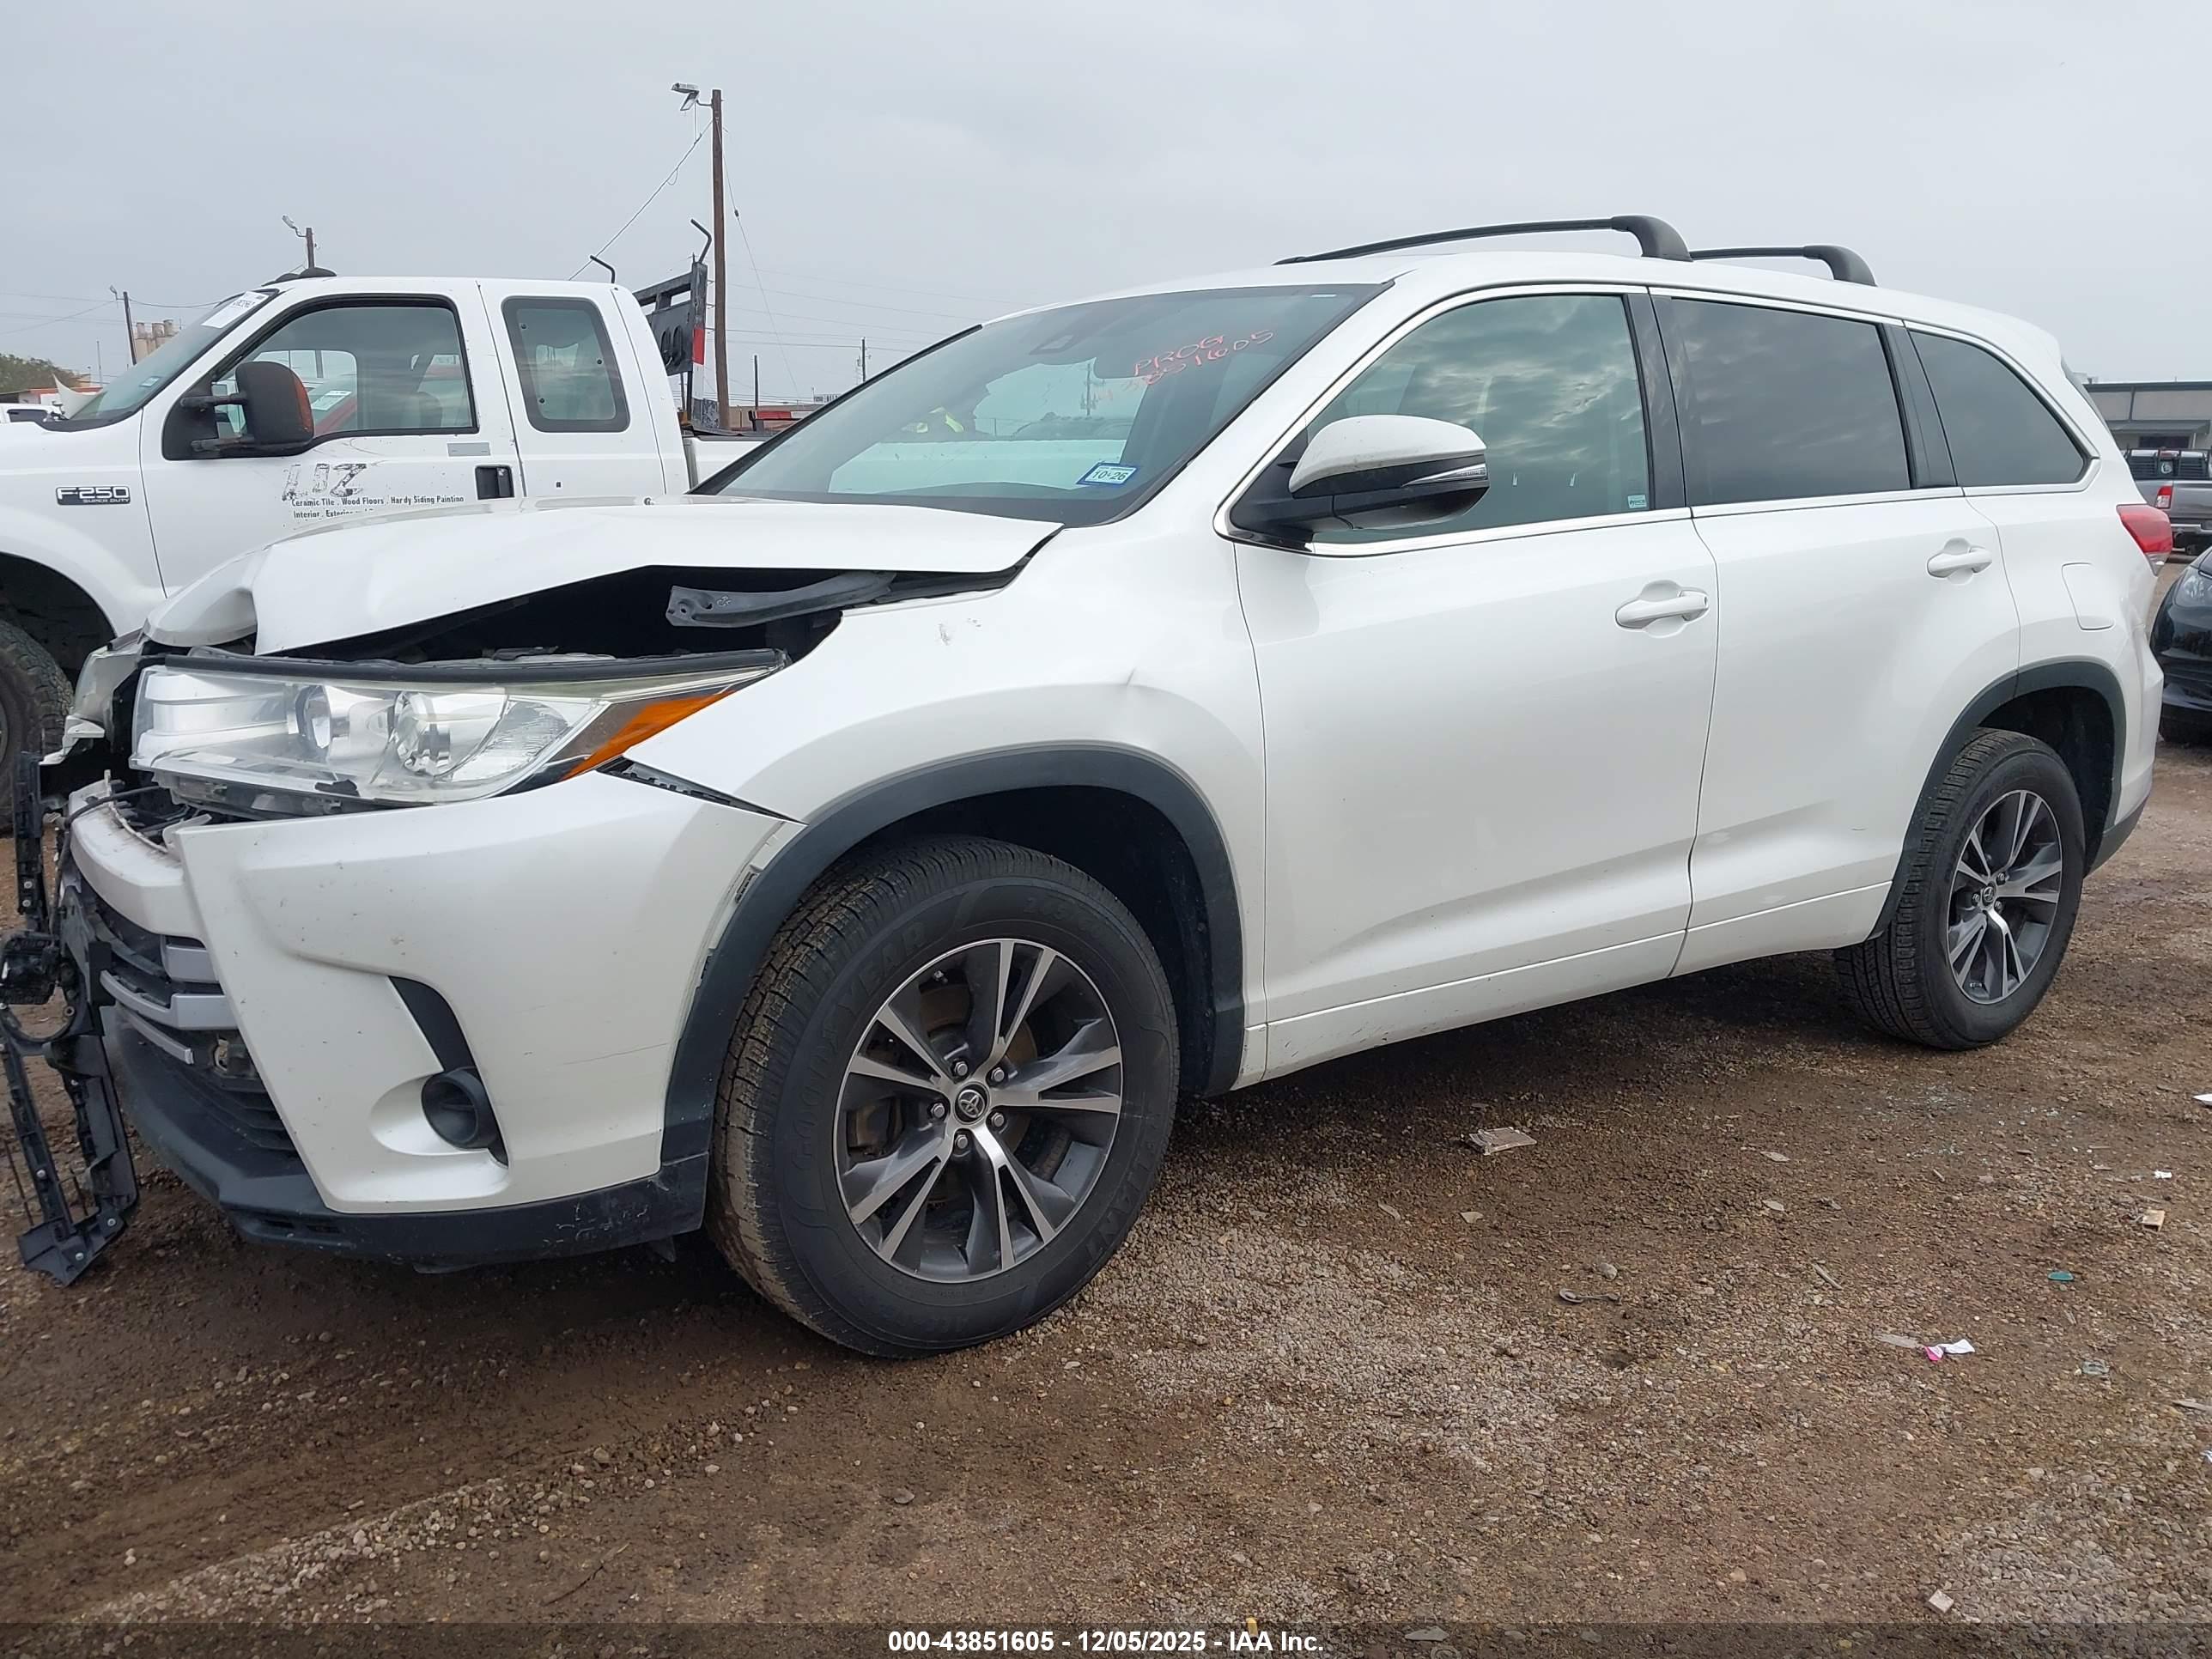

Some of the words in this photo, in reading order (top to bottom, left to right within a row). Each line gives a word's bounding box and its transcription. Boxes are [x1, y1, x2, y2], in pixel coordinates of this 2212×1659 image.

[291, 498, 320, 507] Ceramic
[321, 497, 335, 507] Tile
[341, 497, 361, 506] Wood
[362, 496, 385, 505] Floors
[390, 495, 412, 506] Hardy
[413, 495, 434, 505] Siding
[293, 510, 320, 519] Interior
